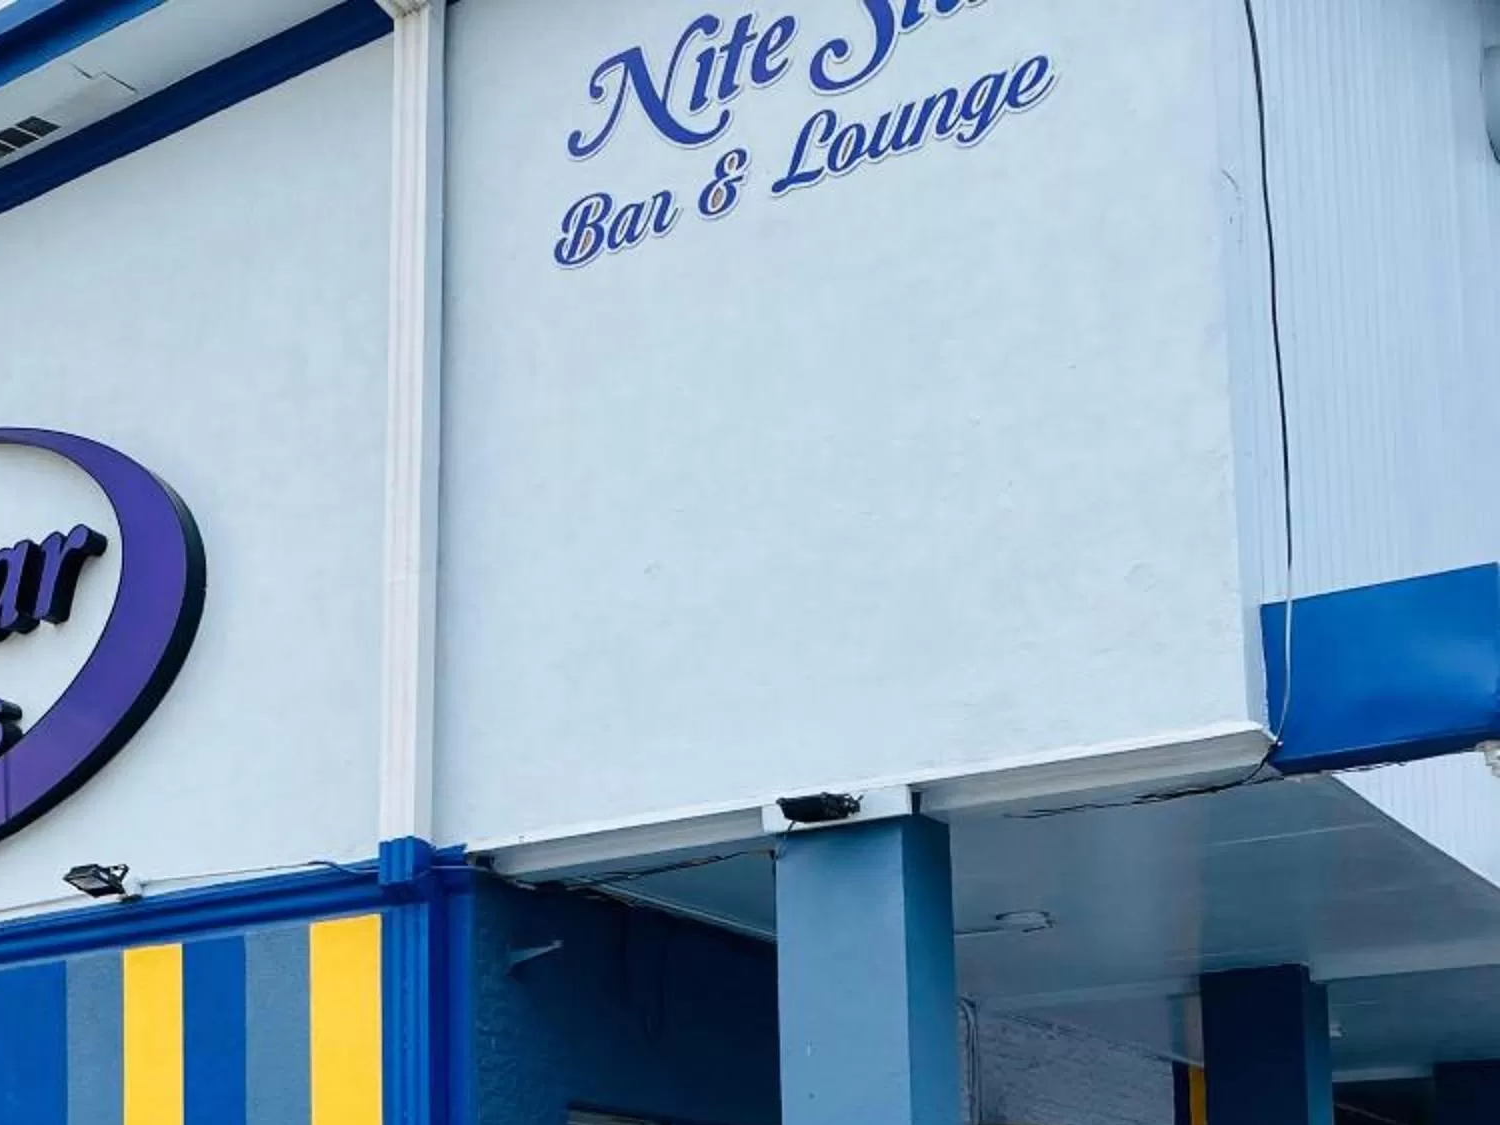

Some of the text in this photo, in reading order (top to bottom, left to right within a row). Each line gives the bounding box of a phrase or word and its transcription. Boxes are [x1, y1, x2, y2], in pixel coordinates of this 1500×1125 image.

[554, 55, 1053, 266] Bar & Lounge
[568, 13, 796, 157] Nite
